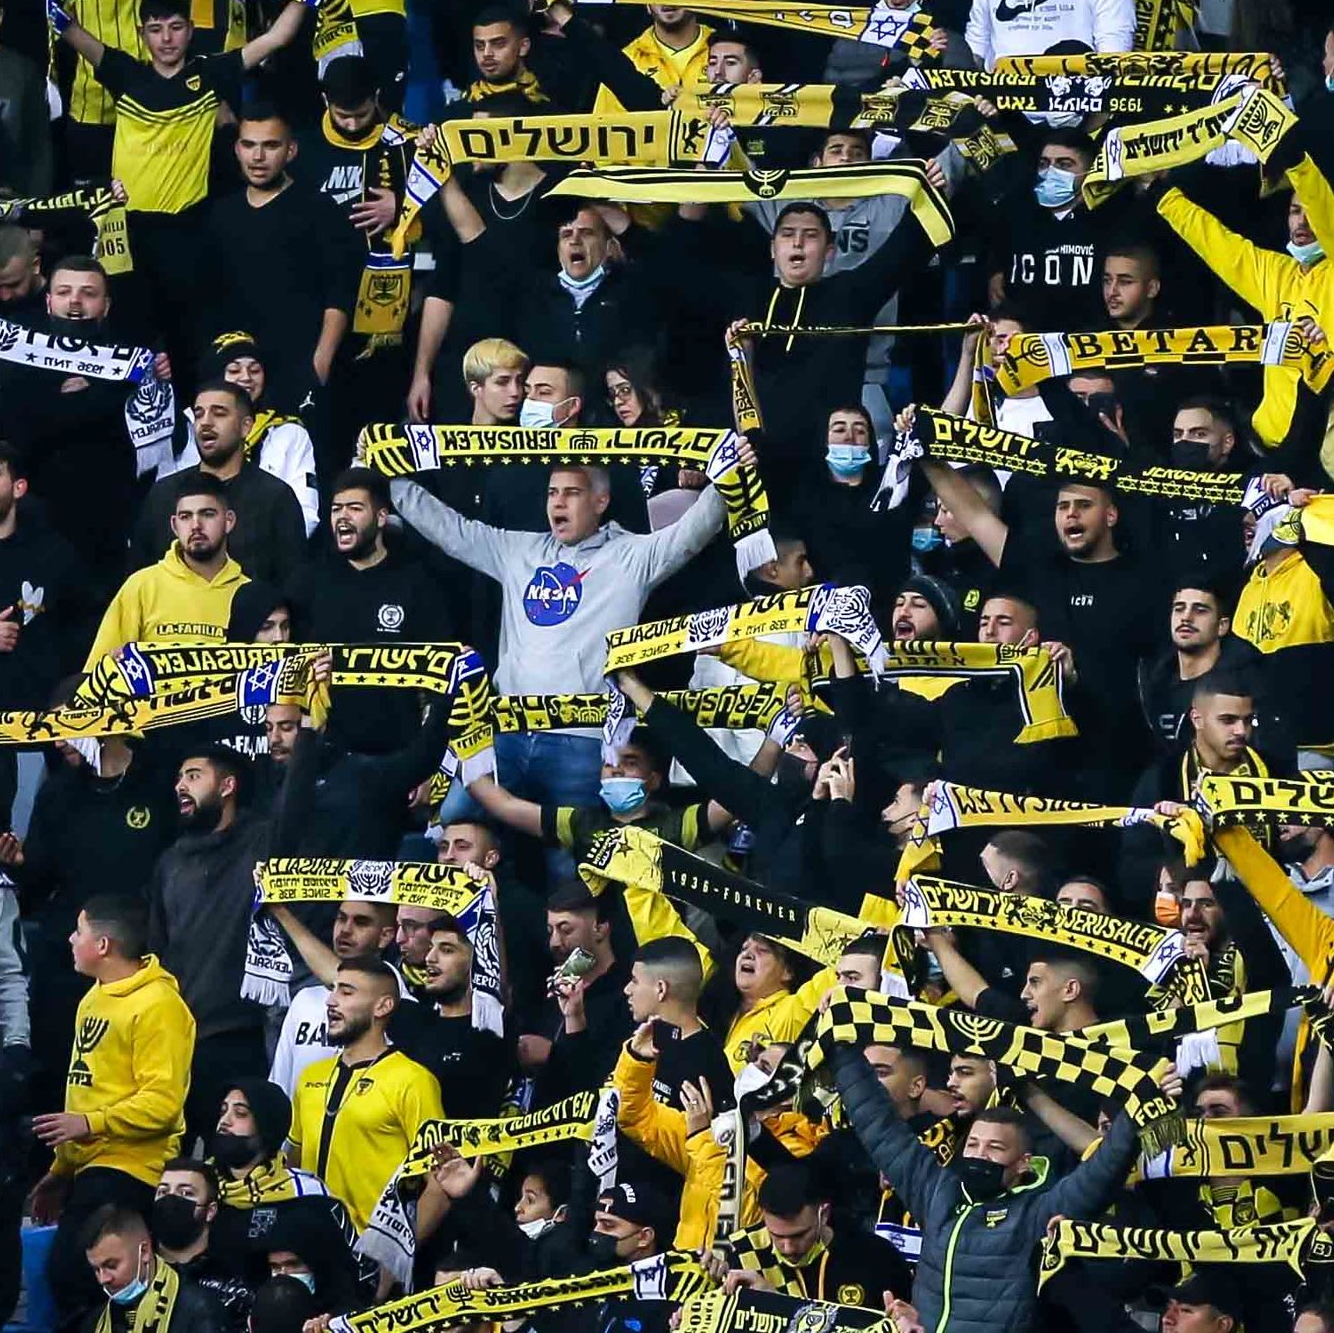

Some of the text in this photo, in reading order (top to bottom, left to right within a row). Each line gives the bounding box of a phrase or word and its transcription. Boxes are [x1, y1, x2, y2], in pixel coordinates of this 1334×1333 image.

[1110, 96, 1143, 112] 1936
[460, 122, 655, 160] ירושלים
[1009, 253, 1095, 287] ICON
[1075, 327, 1262, 357] BETAR
[441, 429, 561, 453] JERUSALEM
[614, 429, 716, 458] ירושלים
[933, 416, 1041, 457] ירושלים
[527, 584, 580, 602] NASA
[157, 623, 224, 637] LA-FAMILIA
[925, 886, 1001, 917] ירושלים
[1063, 905, 1164, 956] JERUSALEM
[1136, 1096, 1178, 1128] FCBJ
